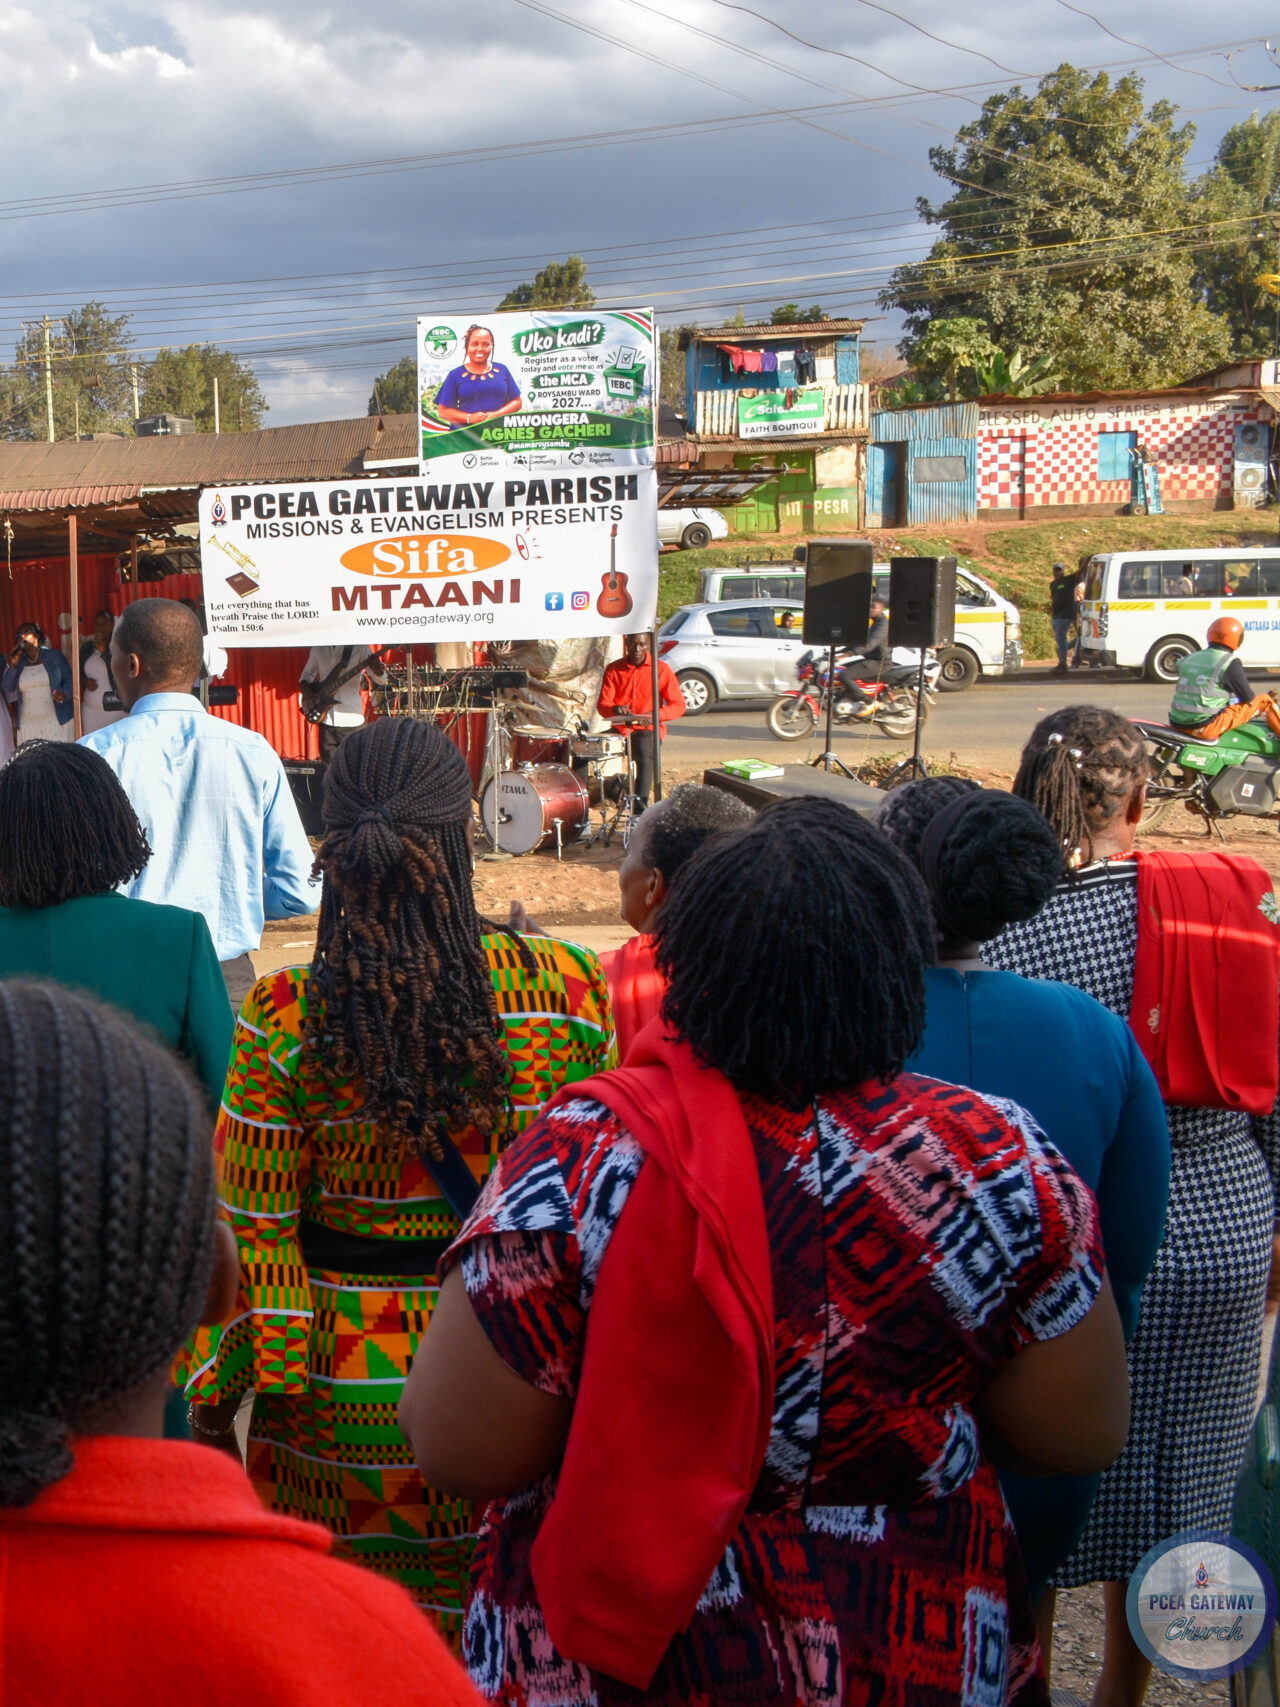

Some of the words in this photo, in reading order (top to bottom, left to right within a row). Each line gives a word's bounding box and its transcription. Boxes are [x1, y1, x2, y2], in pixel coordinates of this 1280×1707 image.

[520, 331, 553, 353] Uko
[557, 323, 601, 347] kadi?
[524, 356, 558, 365] Register
[539, 375, 559, 386] the
[560, 373, 588, 386] MCA
[611, 380, 632, 390] IEBC
[538, 390, 577, 398] ROYSAMBU
[757, 403, 818, 415] Safacom
[977, 409, 1040, 426] BLESSED
[1051, 407, 1096, 422] AUTO
[1107, 404, 1161, 419] SPARES
[1183, 400, 1231, 415] TYRES
[503, 412, 590, 428] MWONGERA
[480, 426, 536, 441] AGNES
[539, 423, 611, 439] GACHERI
[745, 426, 770, 434] FAITH
[772, 422, 817, 432] BOUTIQUE
[508, 439, 570, 450] #mamaroysambu
[230, 491, 320, 521] PCEA
[328, 482, 494, 516] GATEWAY
[505, 475, 639, 507] PARISH
[246, 519, 344, 539] MISSIONS
[350, 518, 364, 534] &
[371, 511, 504, 533] EVANGELISM
[512, 505, 623, 527] PRESENTS
[372, 538, 478, 576] Sifa
[331, 578, 520, 612] MTAANI
[210, 602, 224, 610] Let
[227, 600, 272, 610] everything
[275, 600, 292, 608] that
[211, 612, 239, 622] breath
[242, 612, 268, 620] Praise
[271, 612, 284, 620] the
[287, 611, 319, 620] LORD!
[356, 612, 494, 628] www.pceagateway.org
[241, 624, 264, 632] 150:6
